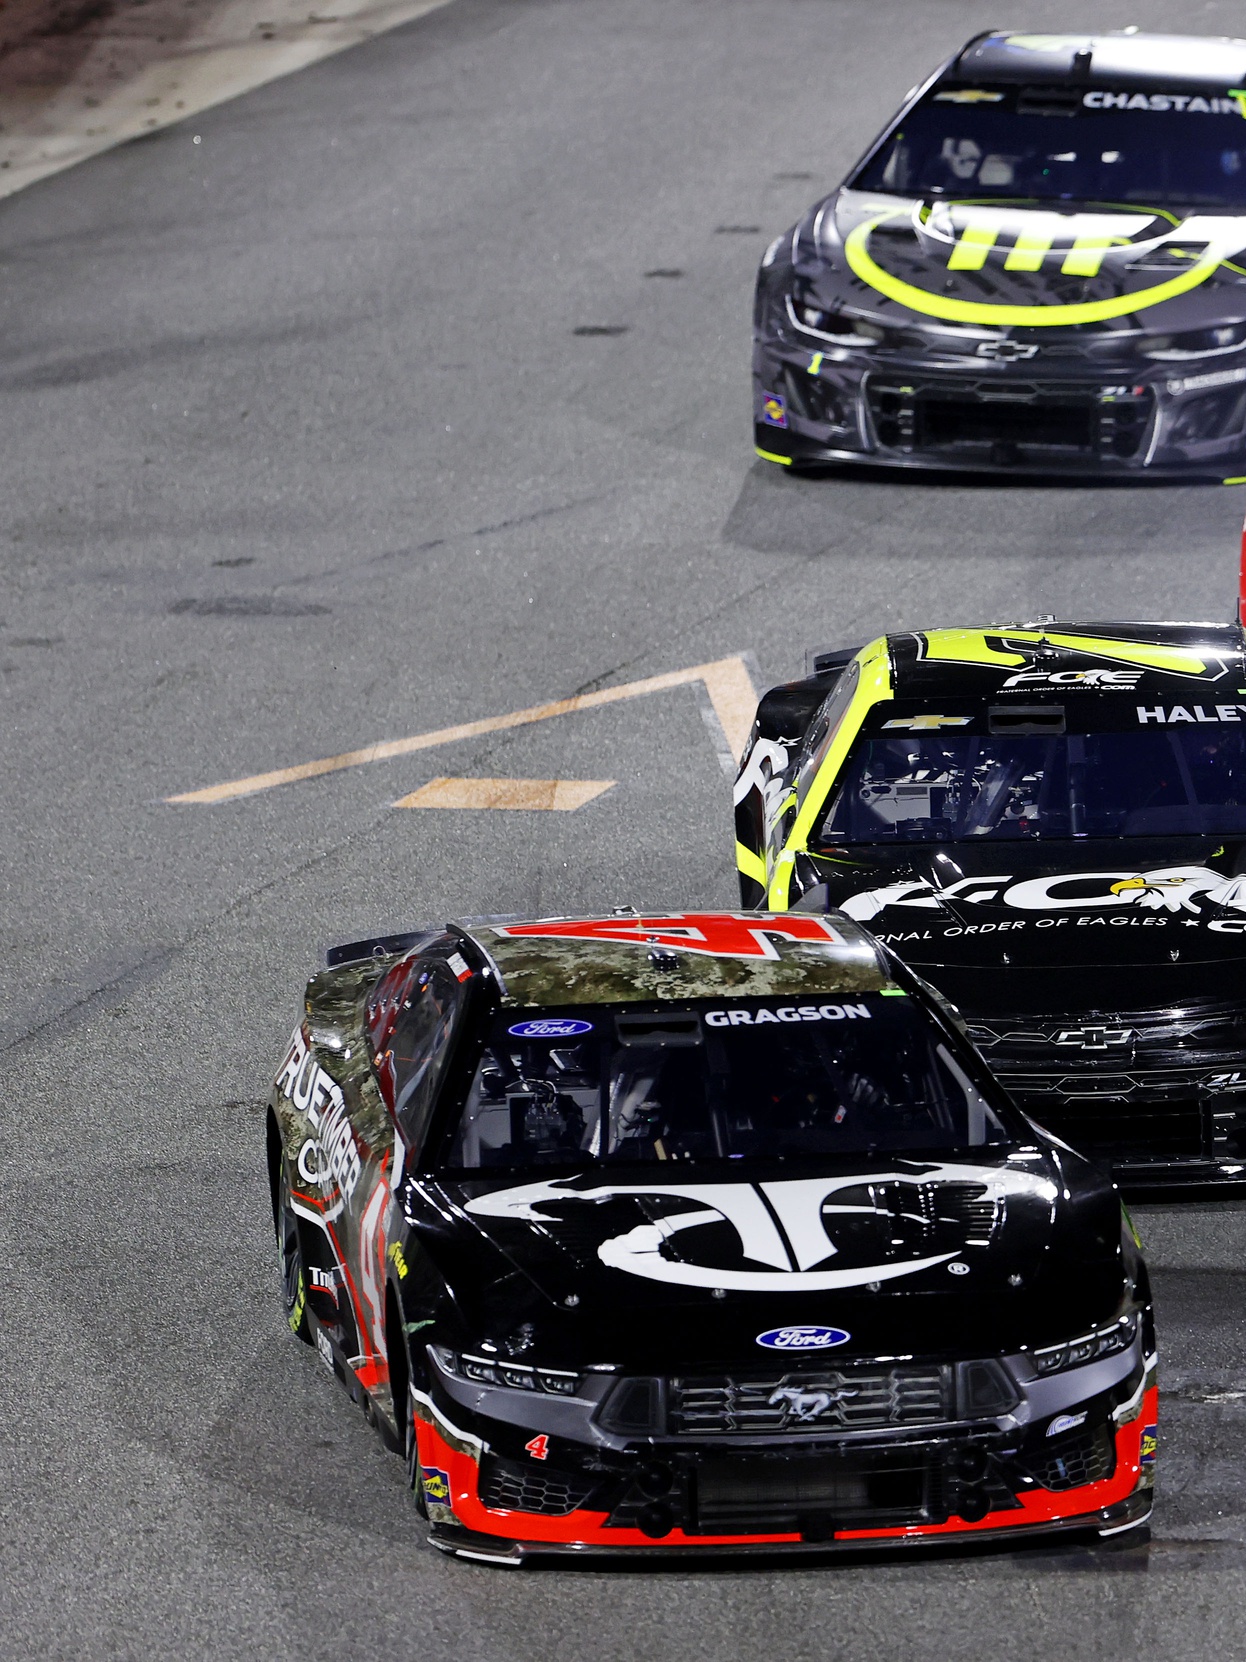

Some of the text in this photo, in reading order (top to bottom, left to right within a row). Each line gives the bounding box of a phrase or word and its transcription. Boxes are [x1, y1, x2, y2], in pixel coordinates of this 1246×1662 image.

[1083, 91, 1244, 115] CHASTAIN
[943, 920, 1026, 937] ORDER
[1035, 917, 1068, 928] OF
[1076, 916, 1168, 927] EAGLES
[704, 1004, 872, 1027] GRAGSON
[773, 1327, 833, 1347] Ford
[524, 1433, 550, 1461] 4
